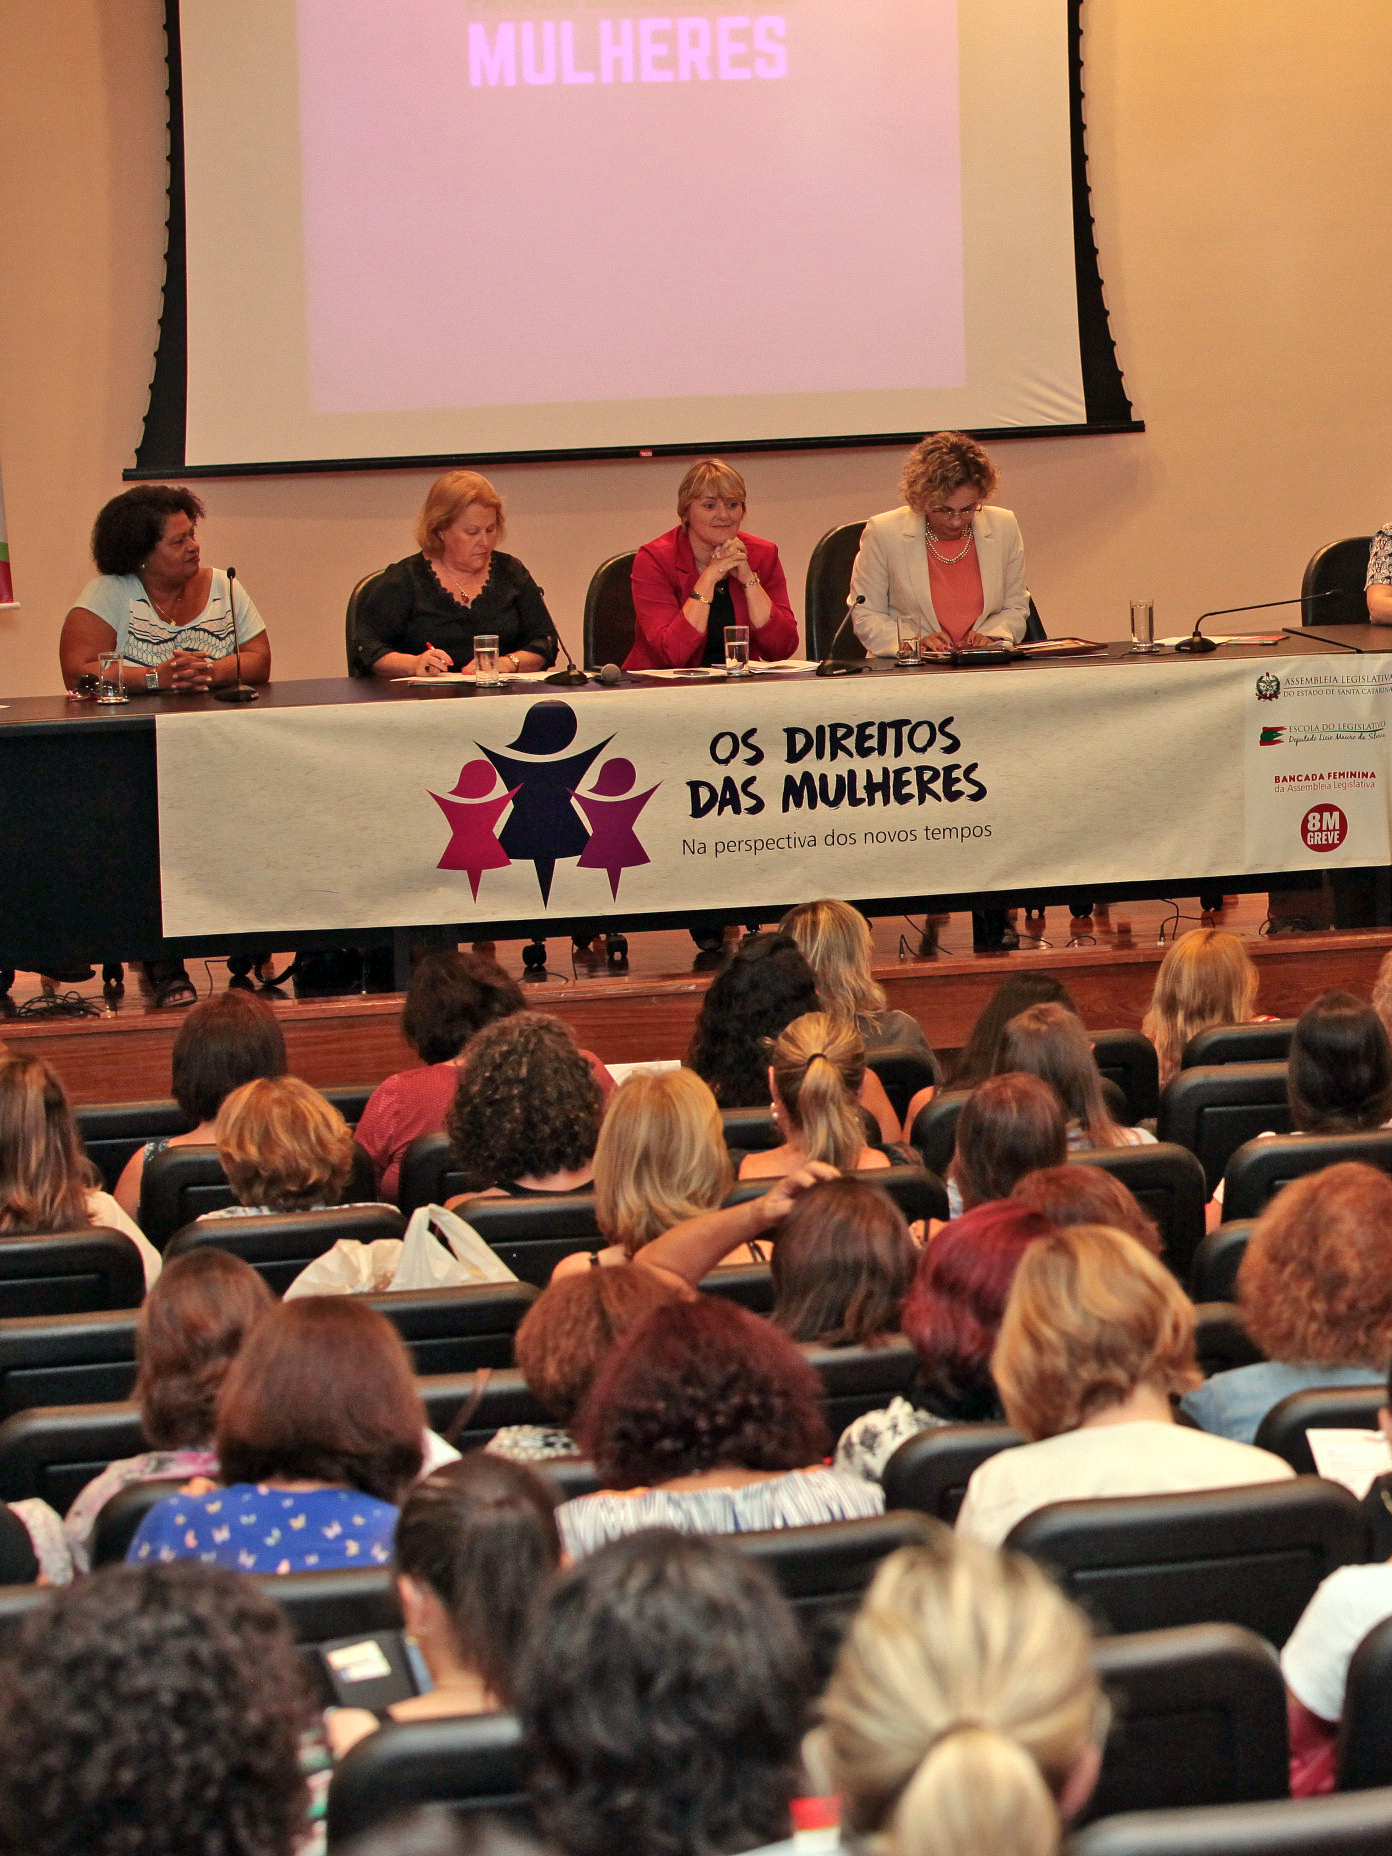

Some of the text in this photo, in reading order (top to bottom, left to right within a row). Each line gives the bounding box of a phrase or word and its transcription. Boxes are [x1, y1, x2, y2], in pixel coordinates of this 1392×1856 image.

[467, 15, 788, 87] MULHERES
[1284, 675, 1339, 686] ASSEMBLEIA
[1283, 690, 1295, 698] DO
[1297, 688, 1324, 697] ESTADO
[1361, 686, 1392, 695] CATARINA
[1289, 724, 1320, 733] ESCOLA
[1322, 723, 1335, 731] DO
[709, 716, 962, 766] OS DIREITOS
[1335, 733, 1356, 741] Mauro
[1356, 732, 1366, 740] da
[1274, 771, 1376, 784] BANCADA FEMININA
[685, 762, 988, 819] DAS MULHERES
[1274, 780, 1375, 793] da Assembleia Legislativa
[1307, 811, 1340, 831] 8M
[682, 823, 993, 858] Na perspectiva dos novos tempos
[1307, 831, 1340, 845] GREVE
